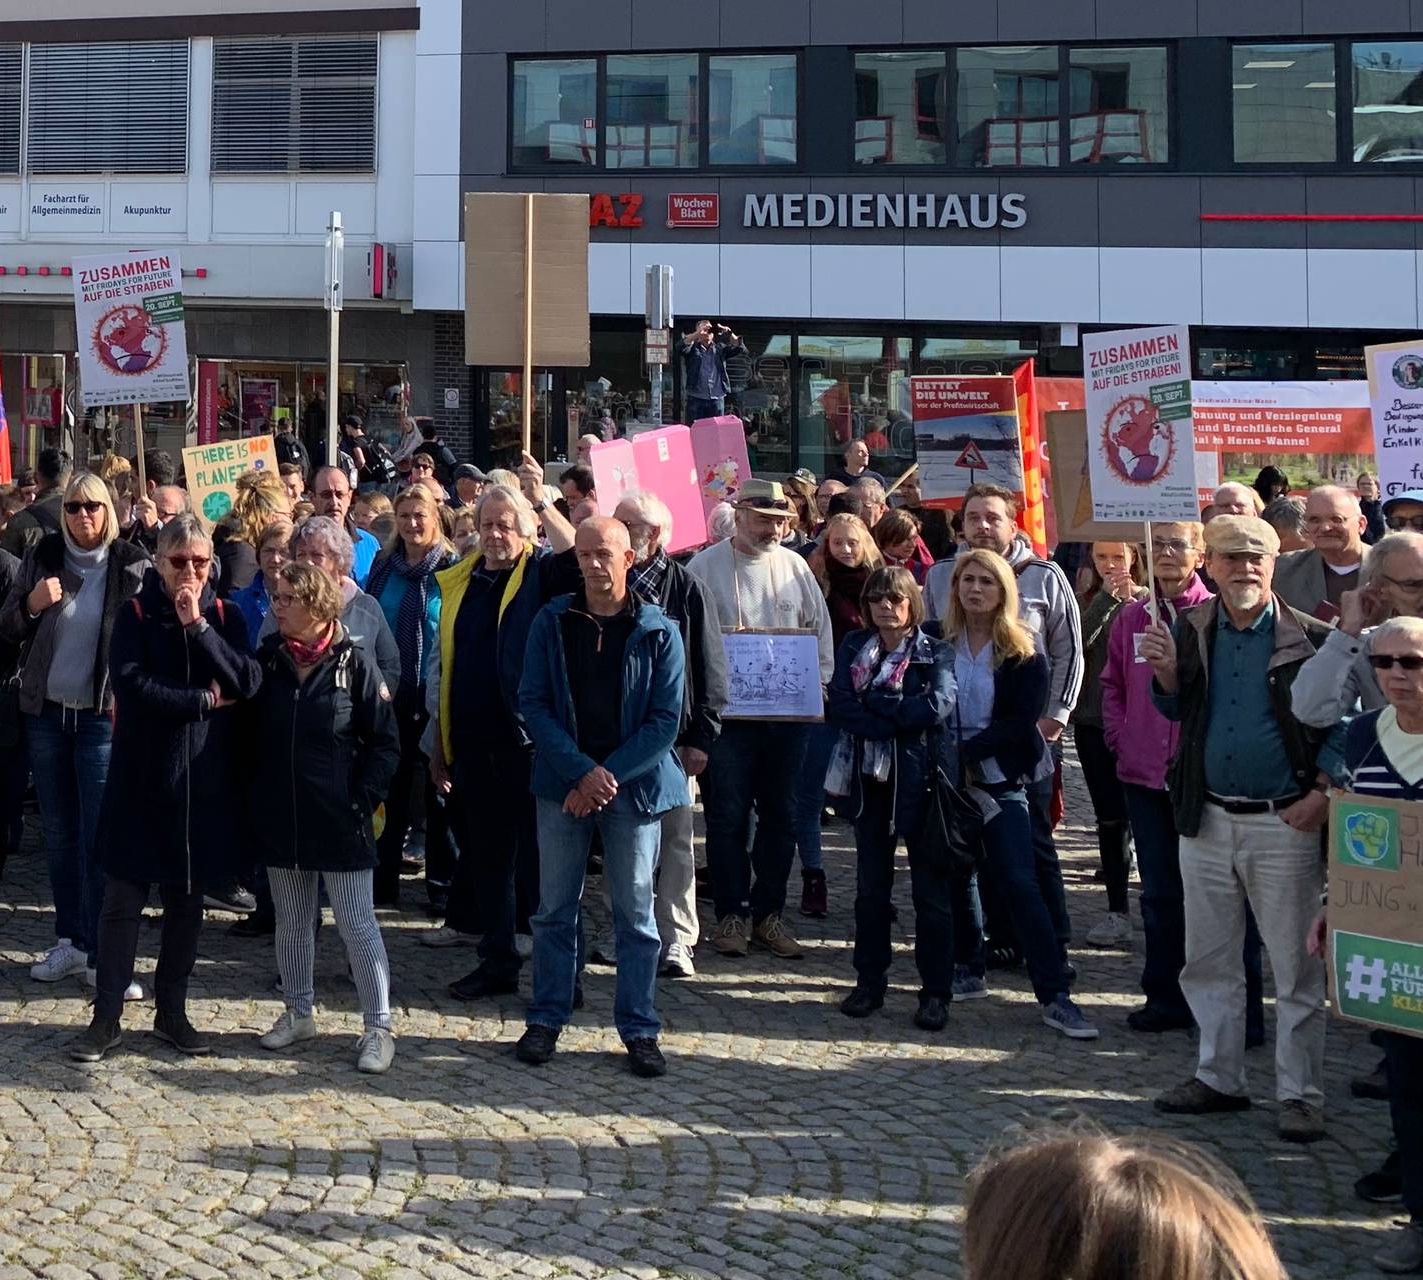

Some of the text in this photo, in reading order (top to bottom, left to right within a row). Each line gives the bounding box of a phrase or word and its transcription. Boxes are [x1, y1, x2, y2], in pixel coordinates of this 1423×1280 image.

[43, 194, 90, 204] Facharzt für
[673, 197, 713, 208] Wochen
[31, 205, 101, 216] Allgemeinmedizin
[123, 205, 171, 216] Akupunktur
[680, 208, 706, 218] Blatt
[743, 193, 1028, 229] MEDIENHAUS
[79, 256, 171, 284] ZUSAMMEN
[81, 271, 172, 293] MIT FRIDAYS FOR FUTURE
[83, 291, 103, 302] AUF
[106, 287, 122, 299] DIE
[1089, 334, 1179, 369] ZUSAMMEN
[1091, 351, 1180, 379] MIT FRIDAYS FOR FUTURE
[914, 381, 961, 390] RETTET
[1092, 376, 1111, 391] AUF
[1113, 372, 1129, 387] DIE
[915, 391, 990, 400] DIE UMWELT
[943, 402, 999, 410] Profitwirtschaft
[1240, 412, 1262, 421] und
[1265, 411, 1342, 422] Versiegelung
[1223, 423, 1292, 433] Brachfläche
[1296, 424, 1341, 433] General
[1227, 436, 1310, 446] Herne-Wanne!
[187, 438, 269, 467] THERE IS NO
[195, 462, 248, 488] PLANET
[1336, 878, 1406, 912] JUNG
